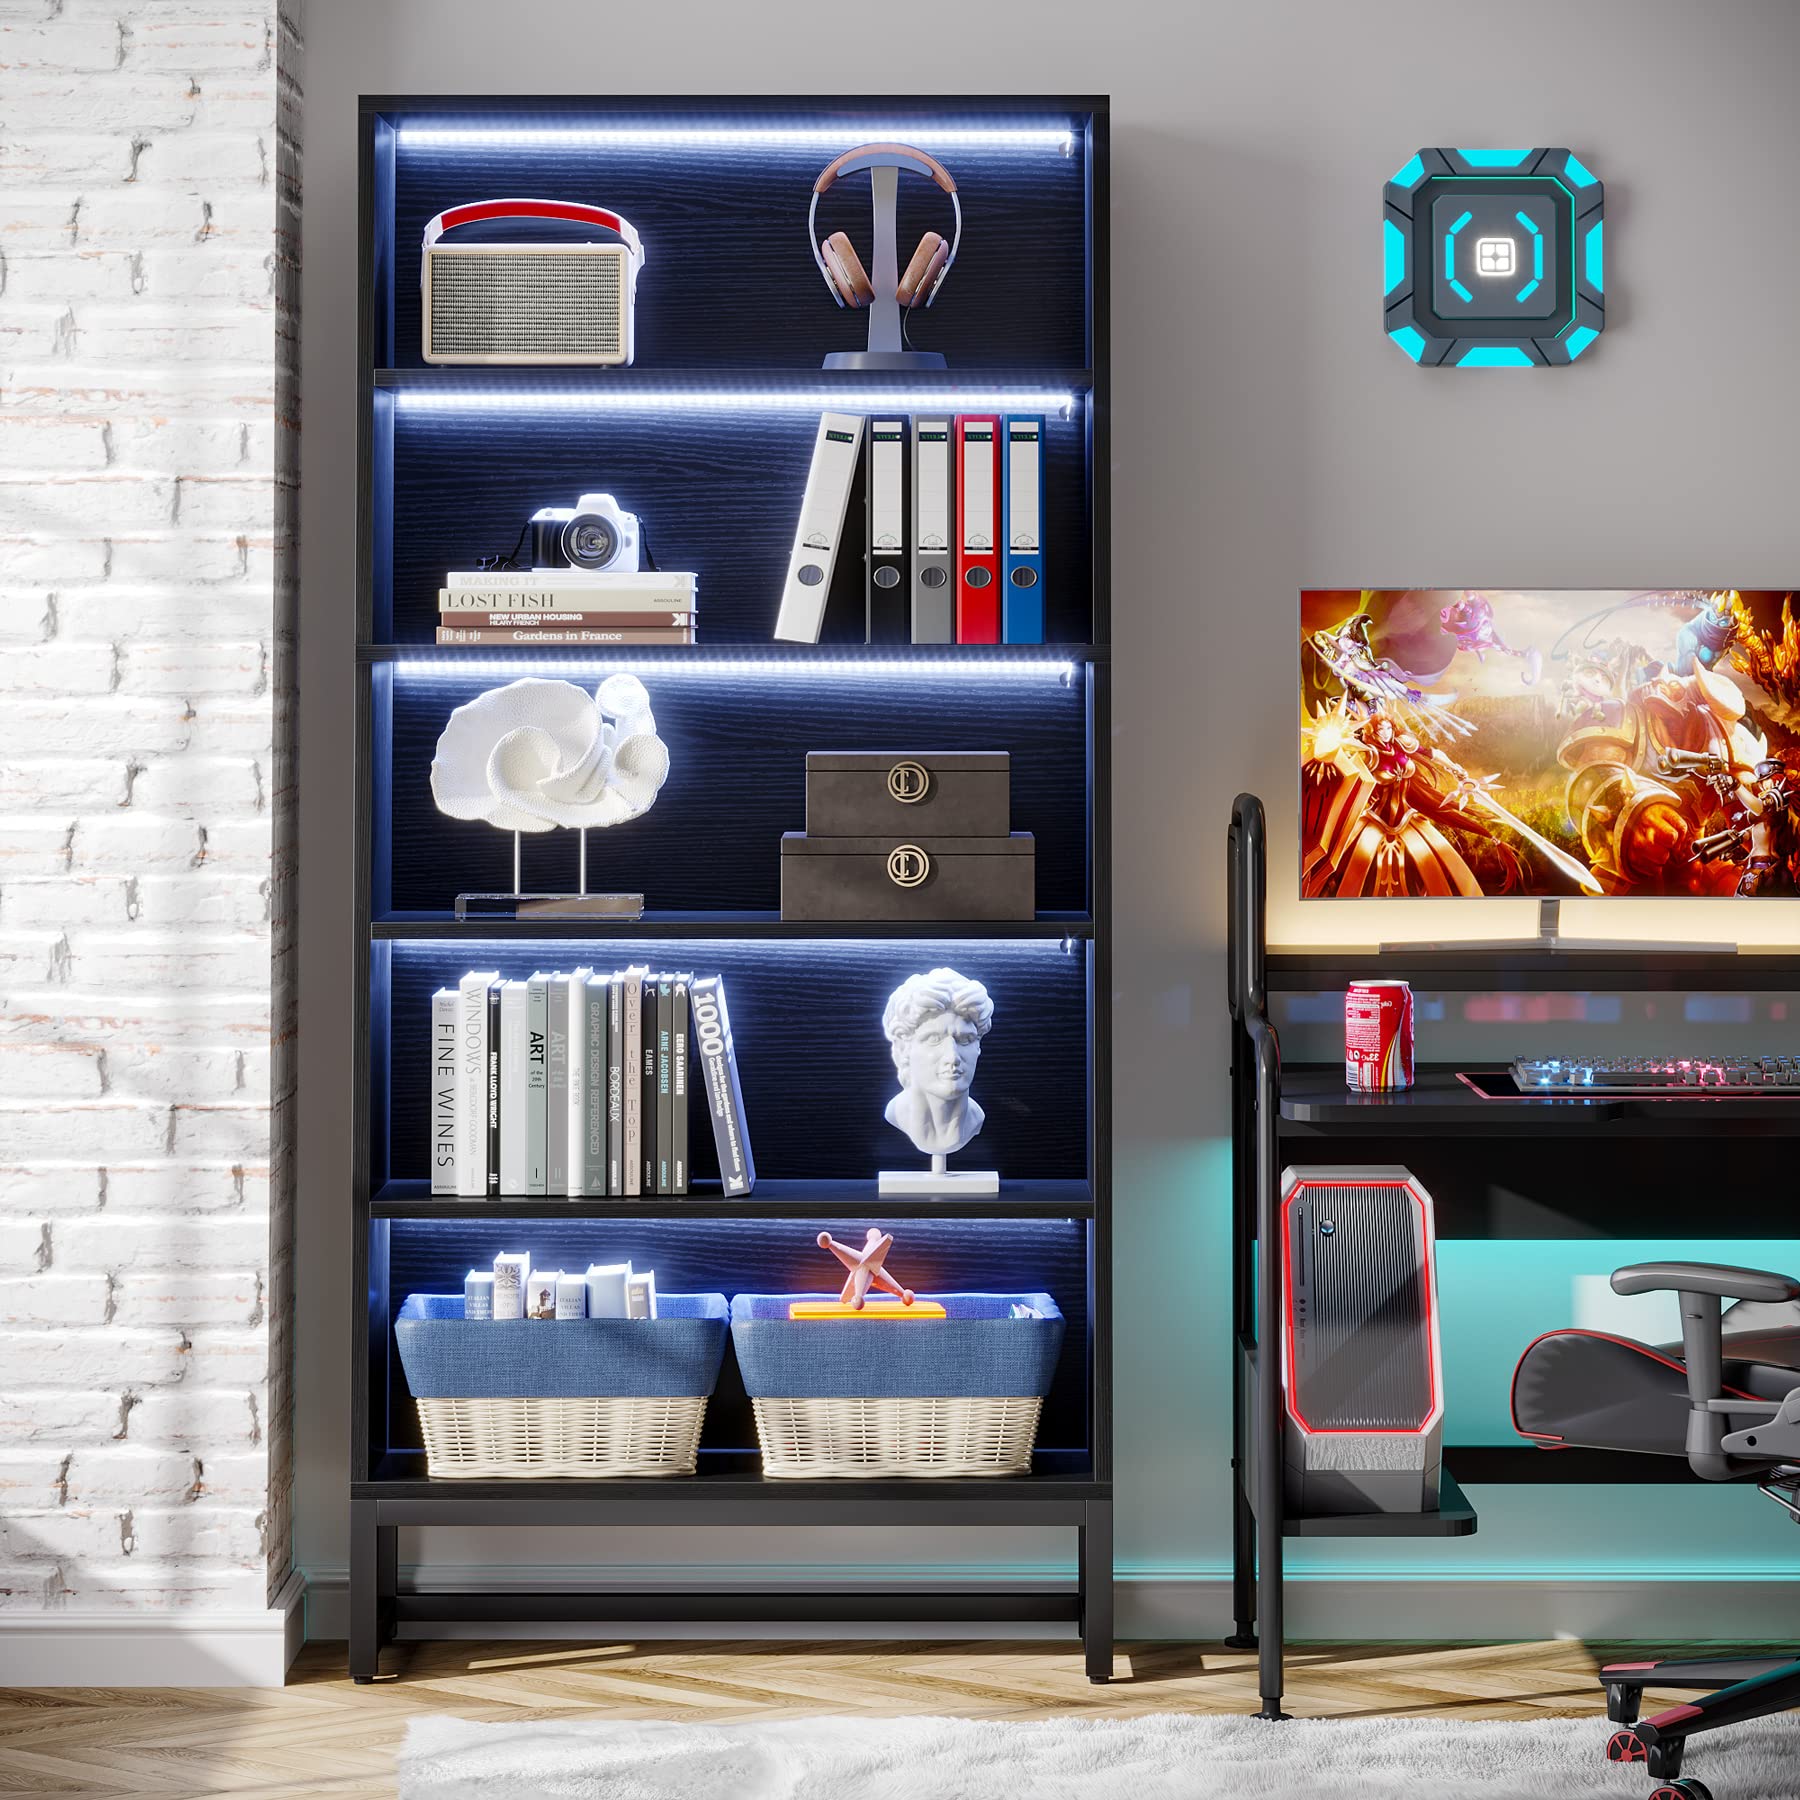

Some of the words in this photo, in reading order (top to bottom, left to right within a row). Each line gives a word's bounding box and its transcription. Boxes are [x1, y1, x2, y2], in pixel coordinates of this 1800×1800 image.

[448, 593, 502, 608] LOST
[508, 593, 554, 608] FISH
[460, 576, 520, 586] MAKING
[524, 576, 539, 586] IT
[513, 631, 563, 640] Gardens
[566, 631, 578, 640] in
[580, 631, 622, 640] France
[590, 1002, 600, 1046] GRAPHIC
[628, 983, 637, 1032] Over
[694, 992, 723, 1055] 1000
[438, 1024, 455, 1076] FINE
[466, 988, 481, 1074] WINDOWS
[530, 1032, 544, 1064] ART
[552, 1032, 566, 1064] ART
[676, 1033, 684, 1053] EERO
[590, 1049, 600, 1086] DESIGN
[676, 1056, 684, 1094] SAARINEN
[610, 1066, 620, 1122] BORDEAUX
[438, 1088, 455, 1167] WINES
[590, 1089, 600, 1155] REFERENCED
